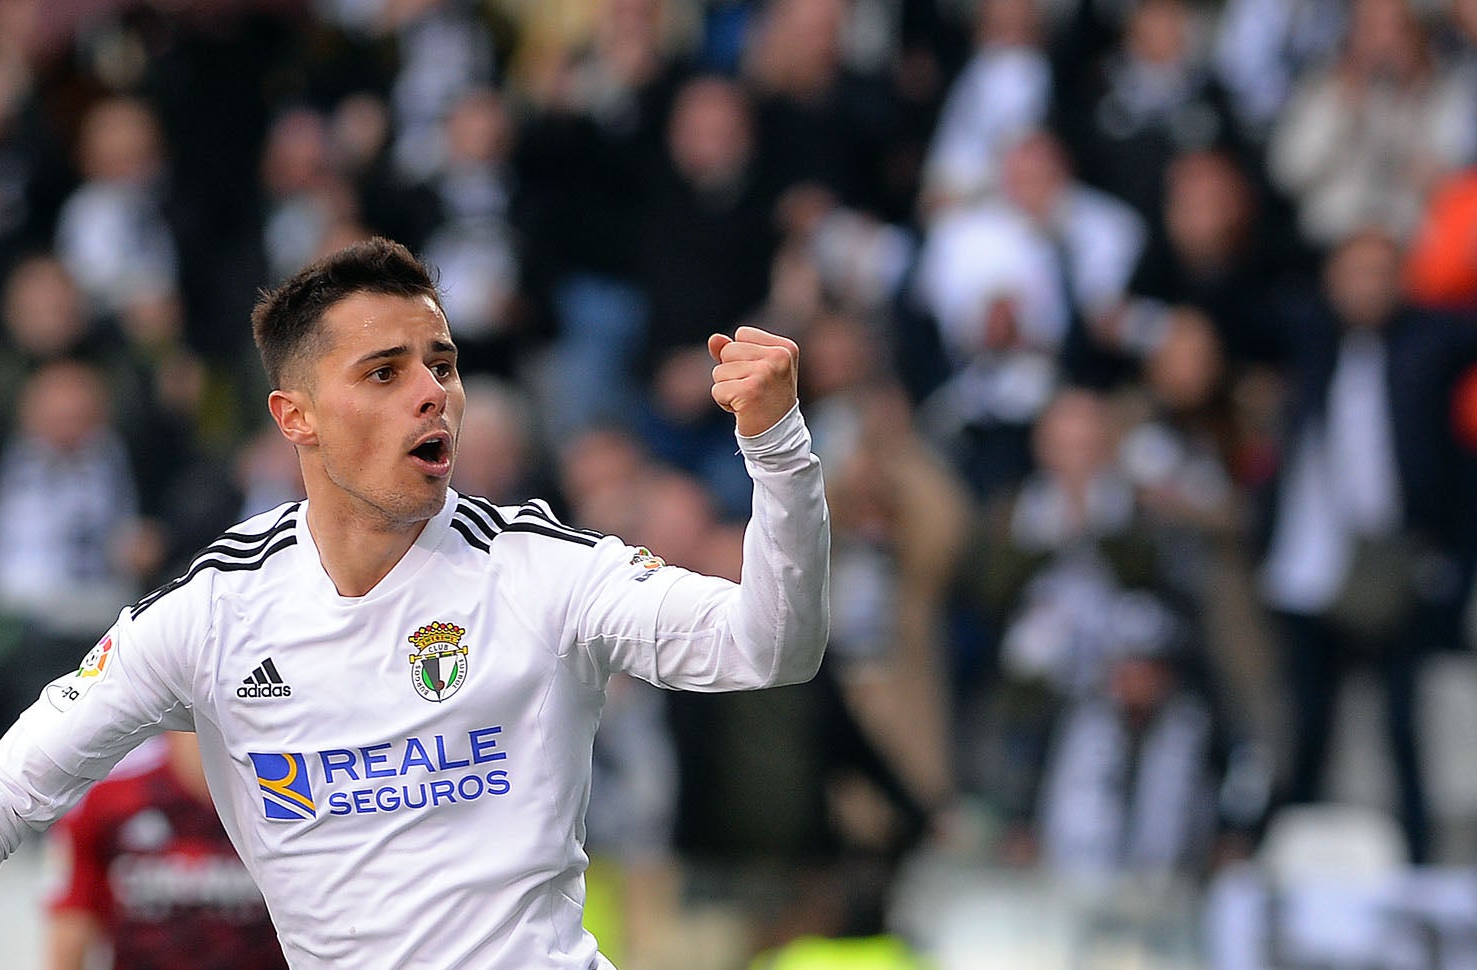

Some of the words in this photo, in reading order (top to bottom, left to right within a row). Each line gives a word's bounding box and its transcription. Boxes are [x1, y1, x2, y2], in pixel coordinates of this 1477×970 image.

[428, 644, 449, 653] CLUB
[236, 682, 292, 698] adidas
[318, 726, 507, 783] REALE
[329, 770, 511, 816] SEGUROS
